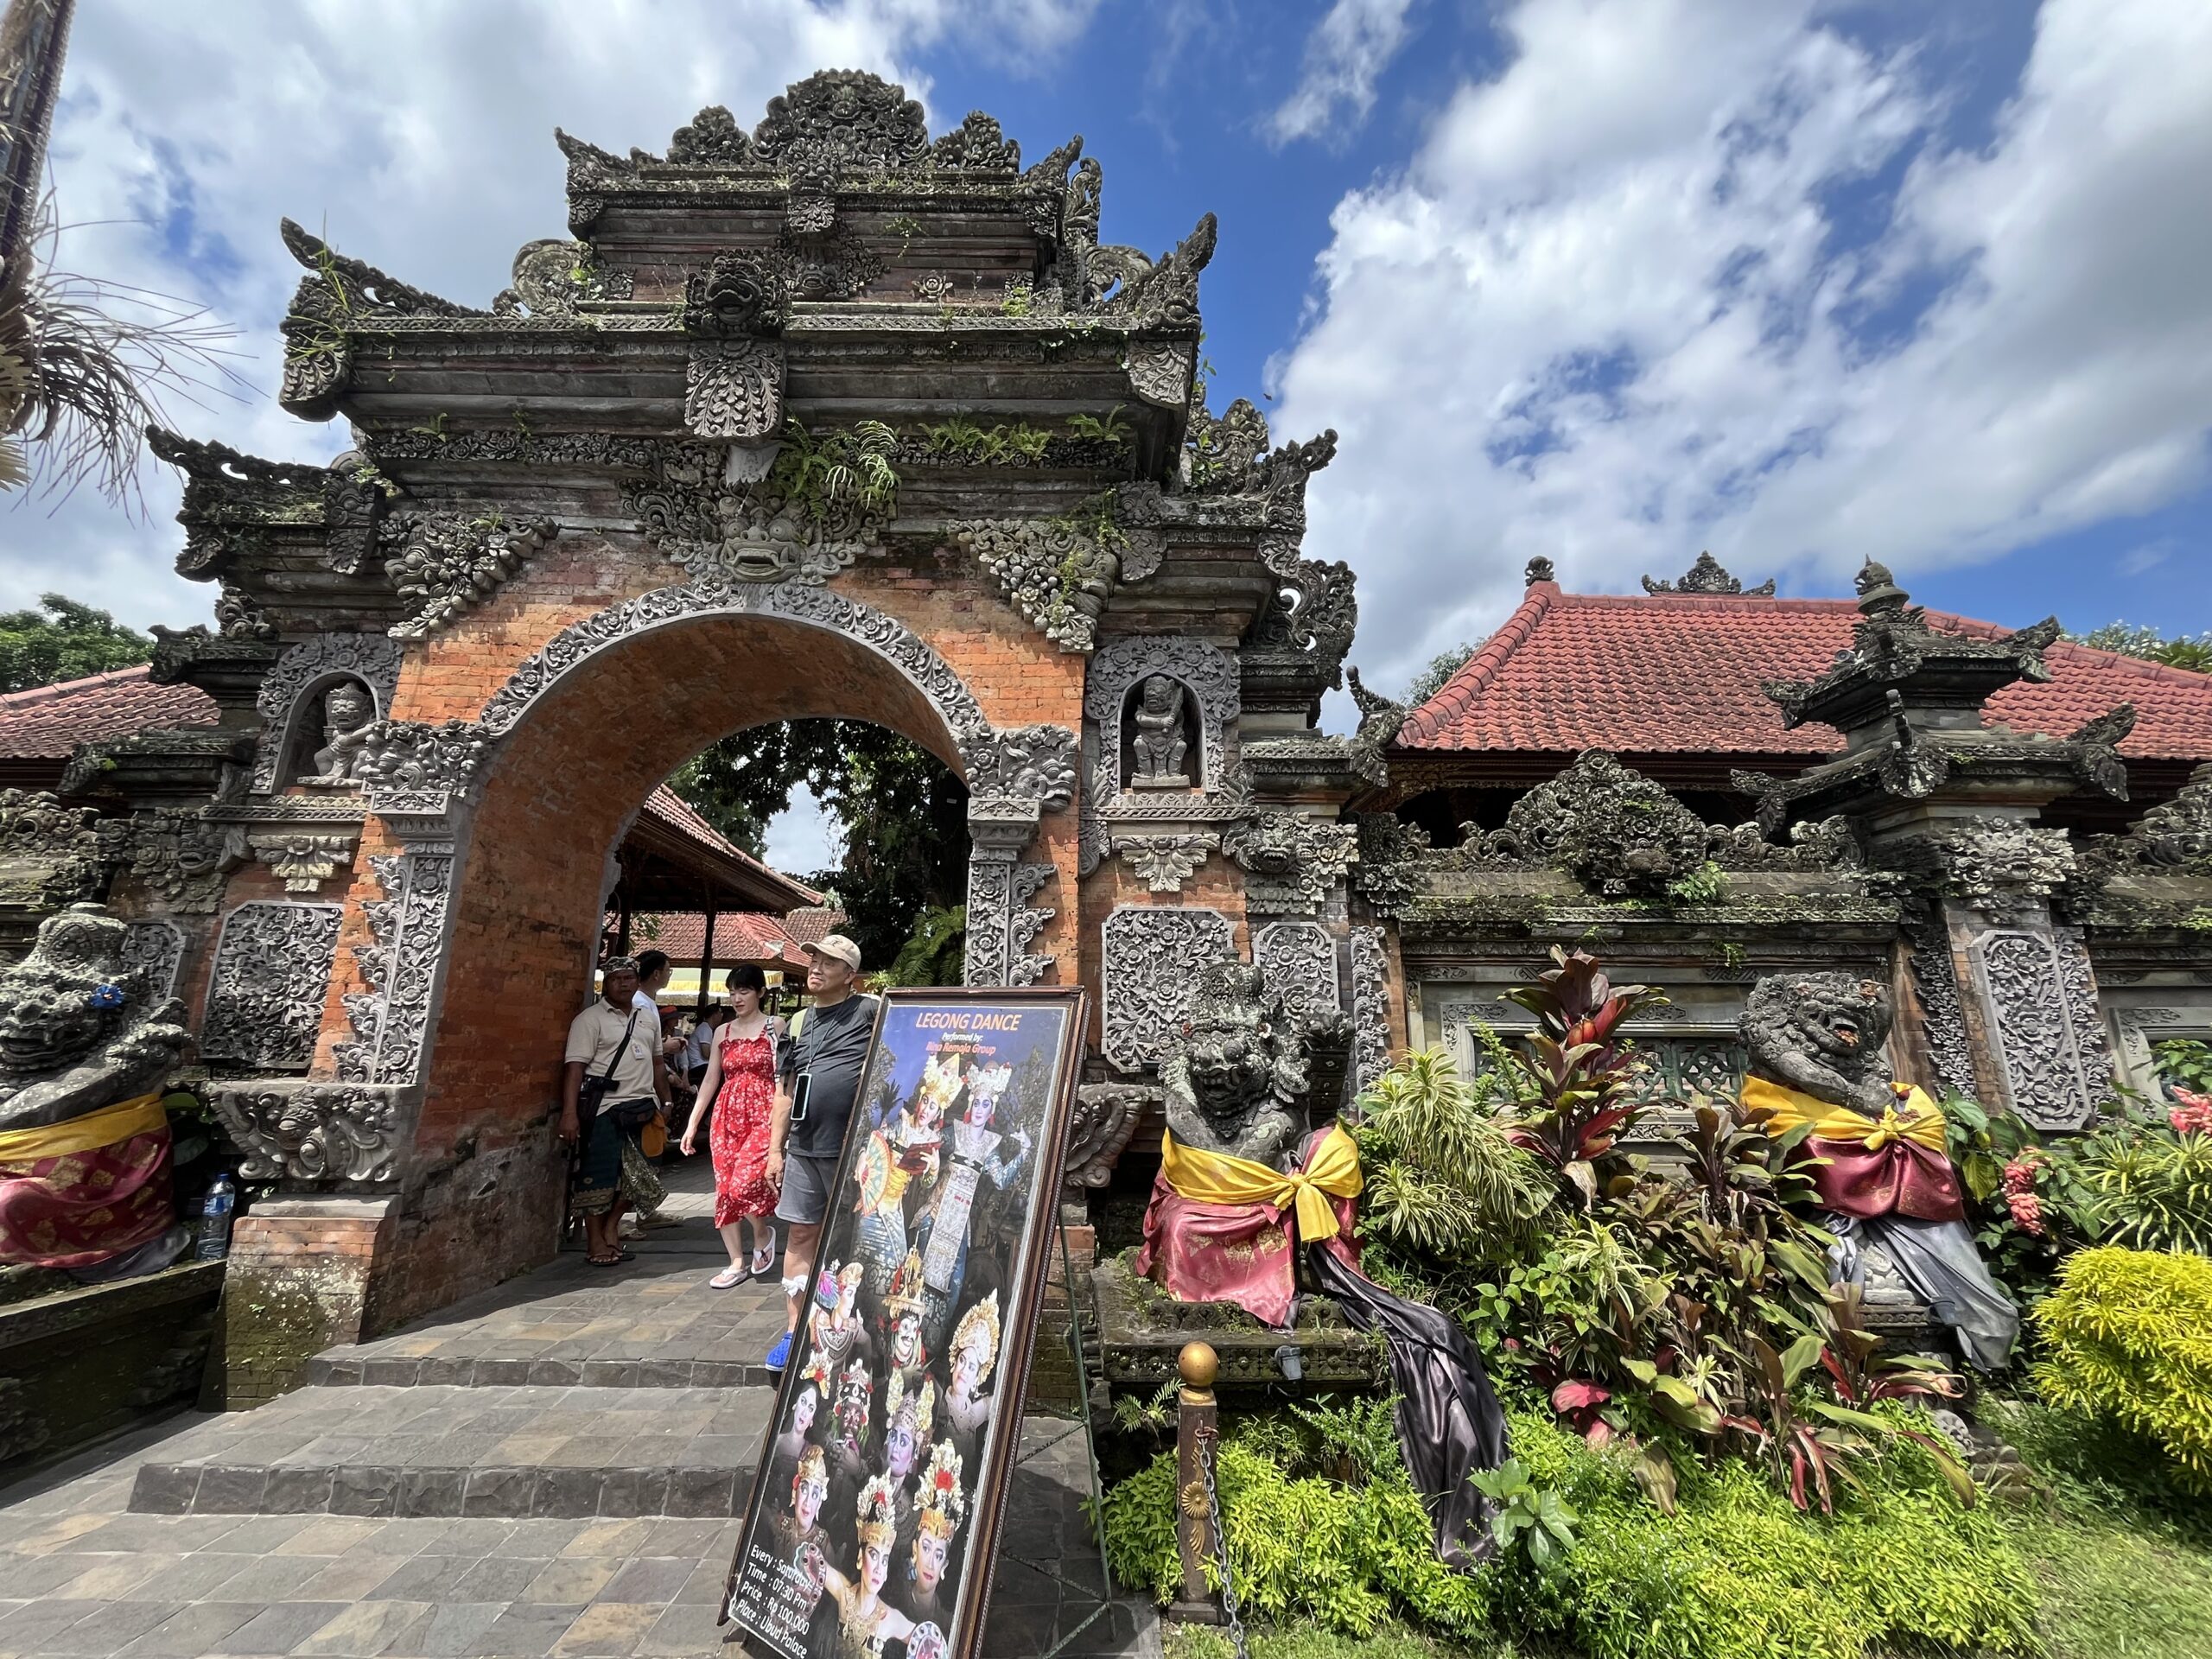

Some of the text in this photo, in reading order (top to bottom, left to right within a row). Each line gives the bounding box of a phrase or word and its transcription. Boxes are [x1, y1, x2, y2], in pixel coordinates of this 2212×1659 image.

[916, 1013, 1023, 1031] LEGONG DANCE
[942, 1032, 973, 1042] Performed
[943, 1042, 971, 1054] Remaja
[972, 1044, 996, 1056] Group
[747, 1562, 767, 1583] Time
[772, 1578, 794, 1601] 07:30
[792, 1592, 807, 1611] Pm
[751, 1544, 773, 1567] Every
[777, 1559, 810, 1592] Saturday
[736, 1599, 757, 1623] Place
[760, 1615, 783, 1640] Ubud
[780, 1631, 808, 1659] Palace
[741, 1581, 762, 1601] Price
[767, 1597, 778, 1614] Rp
[778, 1605, 810, 1635] 100.000
